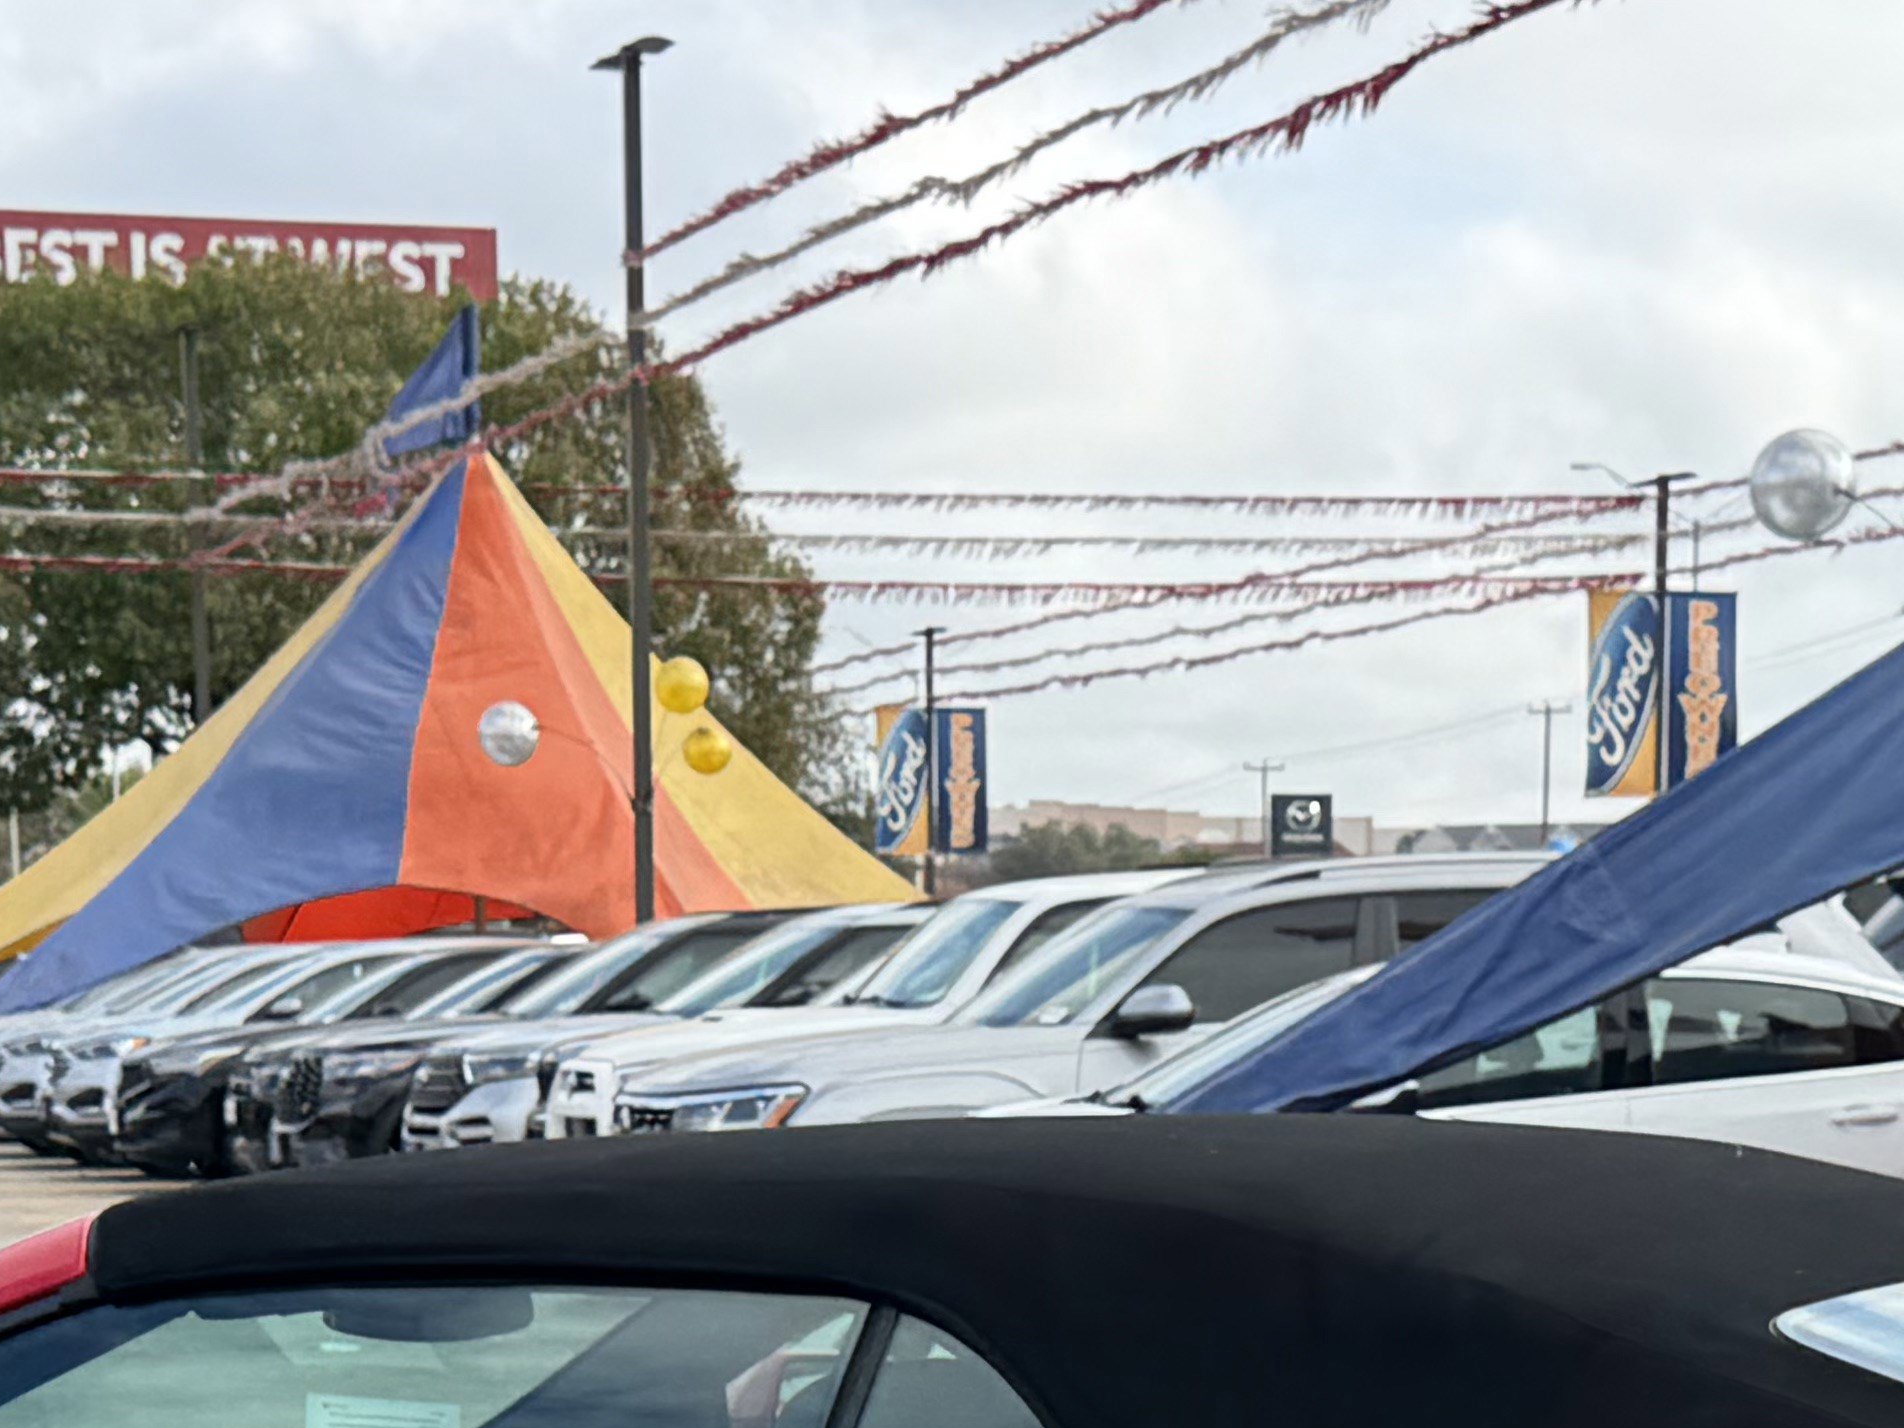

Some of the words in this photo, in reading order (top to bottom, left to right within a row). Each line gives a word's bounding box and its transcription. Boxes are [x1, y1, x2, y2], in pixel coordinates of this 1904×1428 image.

[129, 230, 188, 289] IS
[1586, 624, 1655, 767] Ford
[876, 730, 927, 832] Ford
